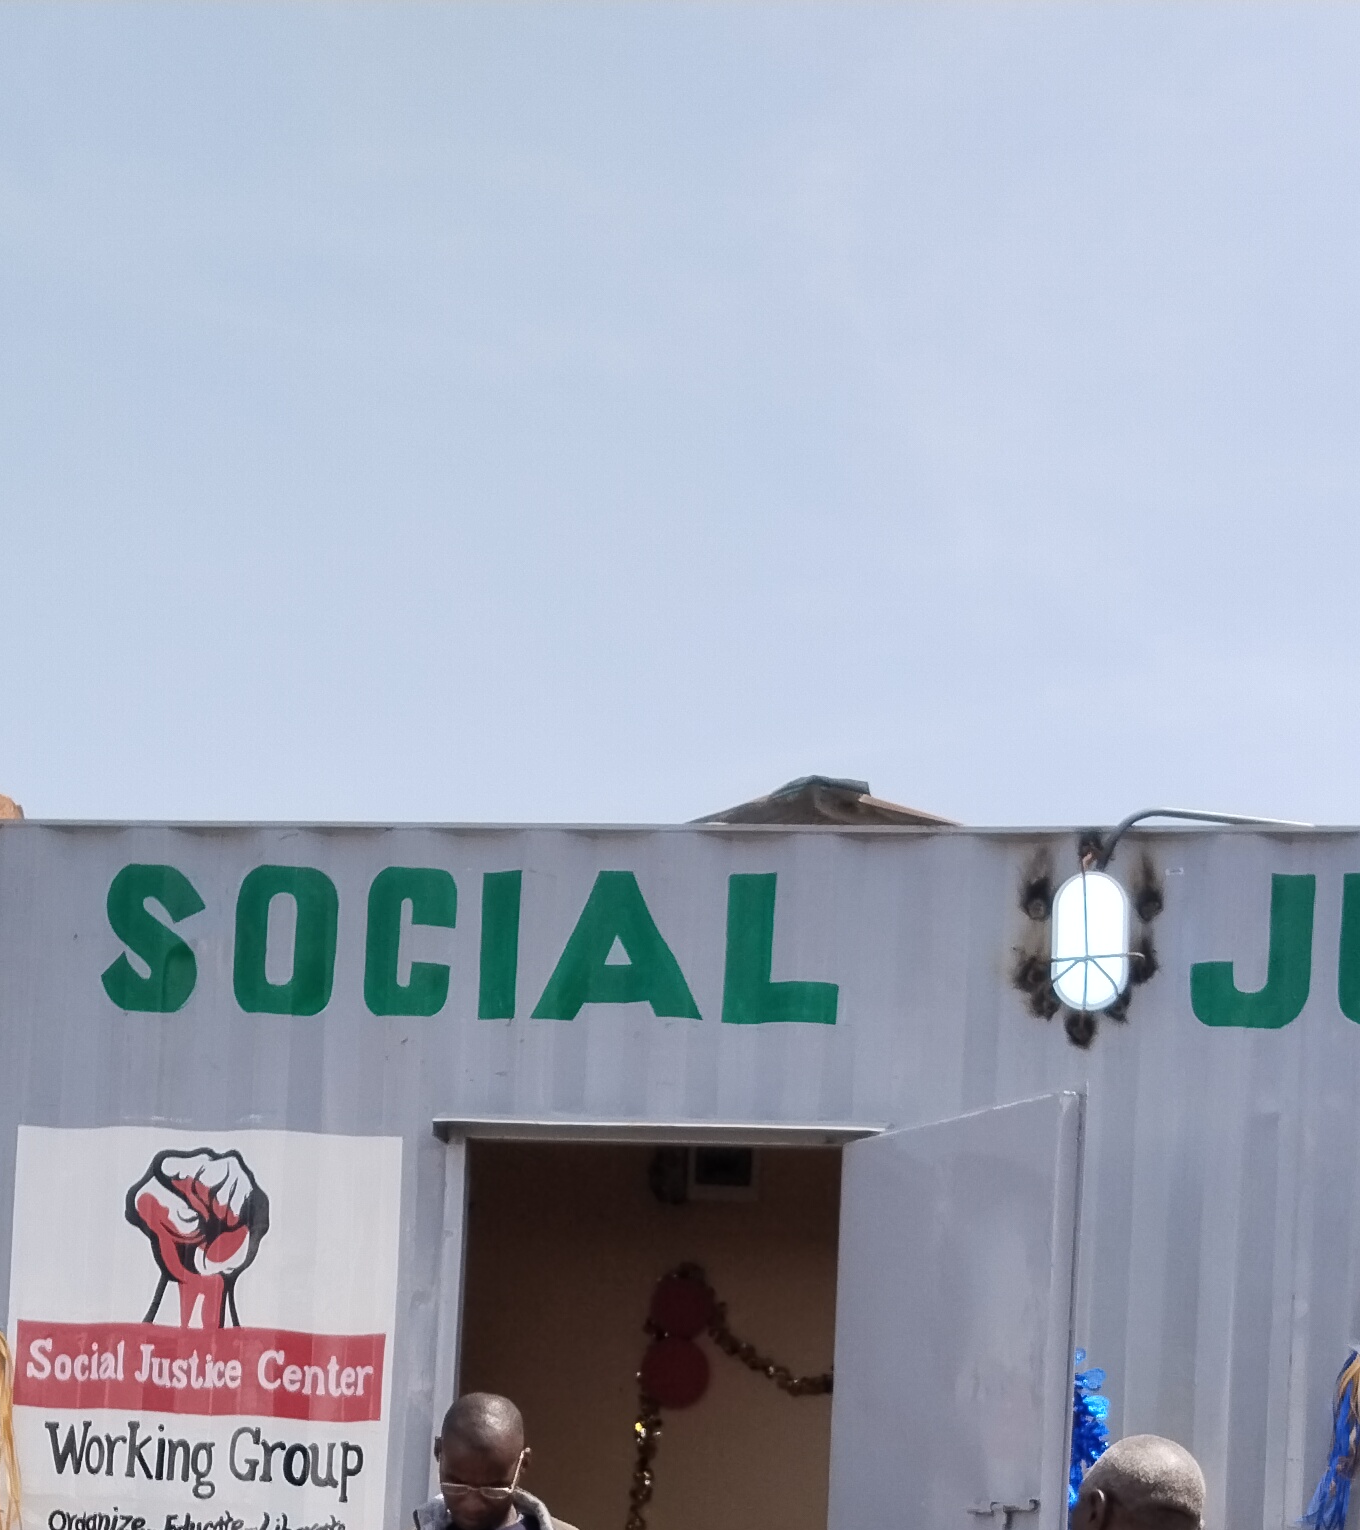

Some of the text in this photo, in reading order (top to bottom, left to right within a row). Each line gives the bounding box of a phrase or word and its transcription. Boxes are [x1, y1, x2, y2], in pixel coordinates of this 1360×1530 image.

[100, 863, 840, 1025] SOCIAL
[26, 1338, 375, 1398] Social Justice Center
[44, 1420, 365, 1503] Working Group
